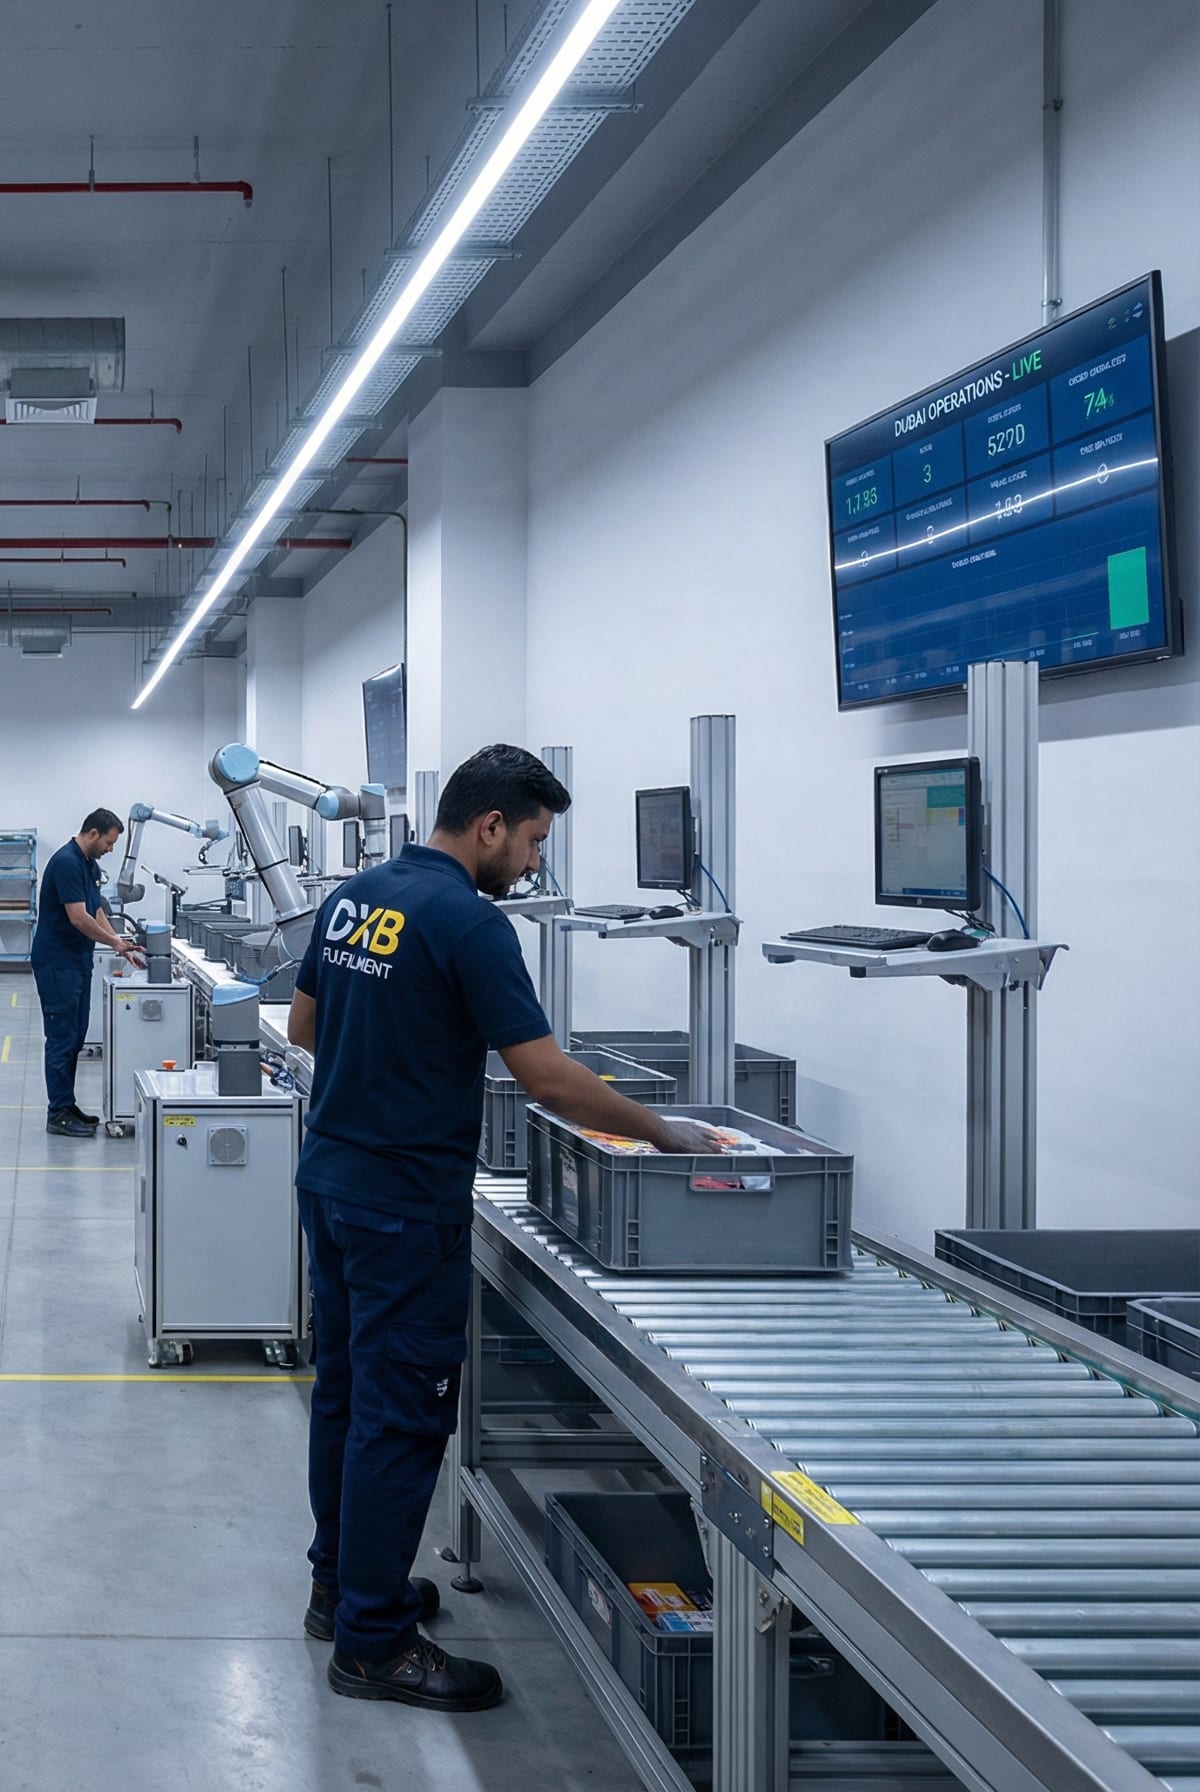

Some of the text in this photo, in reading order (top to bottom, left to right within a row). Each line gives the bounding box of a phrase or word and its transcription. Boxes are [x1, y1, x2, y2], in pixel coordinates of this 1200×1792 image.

[894, 408, 926, 437] DUBAI
[928, 369, 1003, 420] OPERATIONS
[1012, 349, 1043, 381] LIVE
[923, 464, 932, 483] 3
[325, 898, 406, 956] DXB
